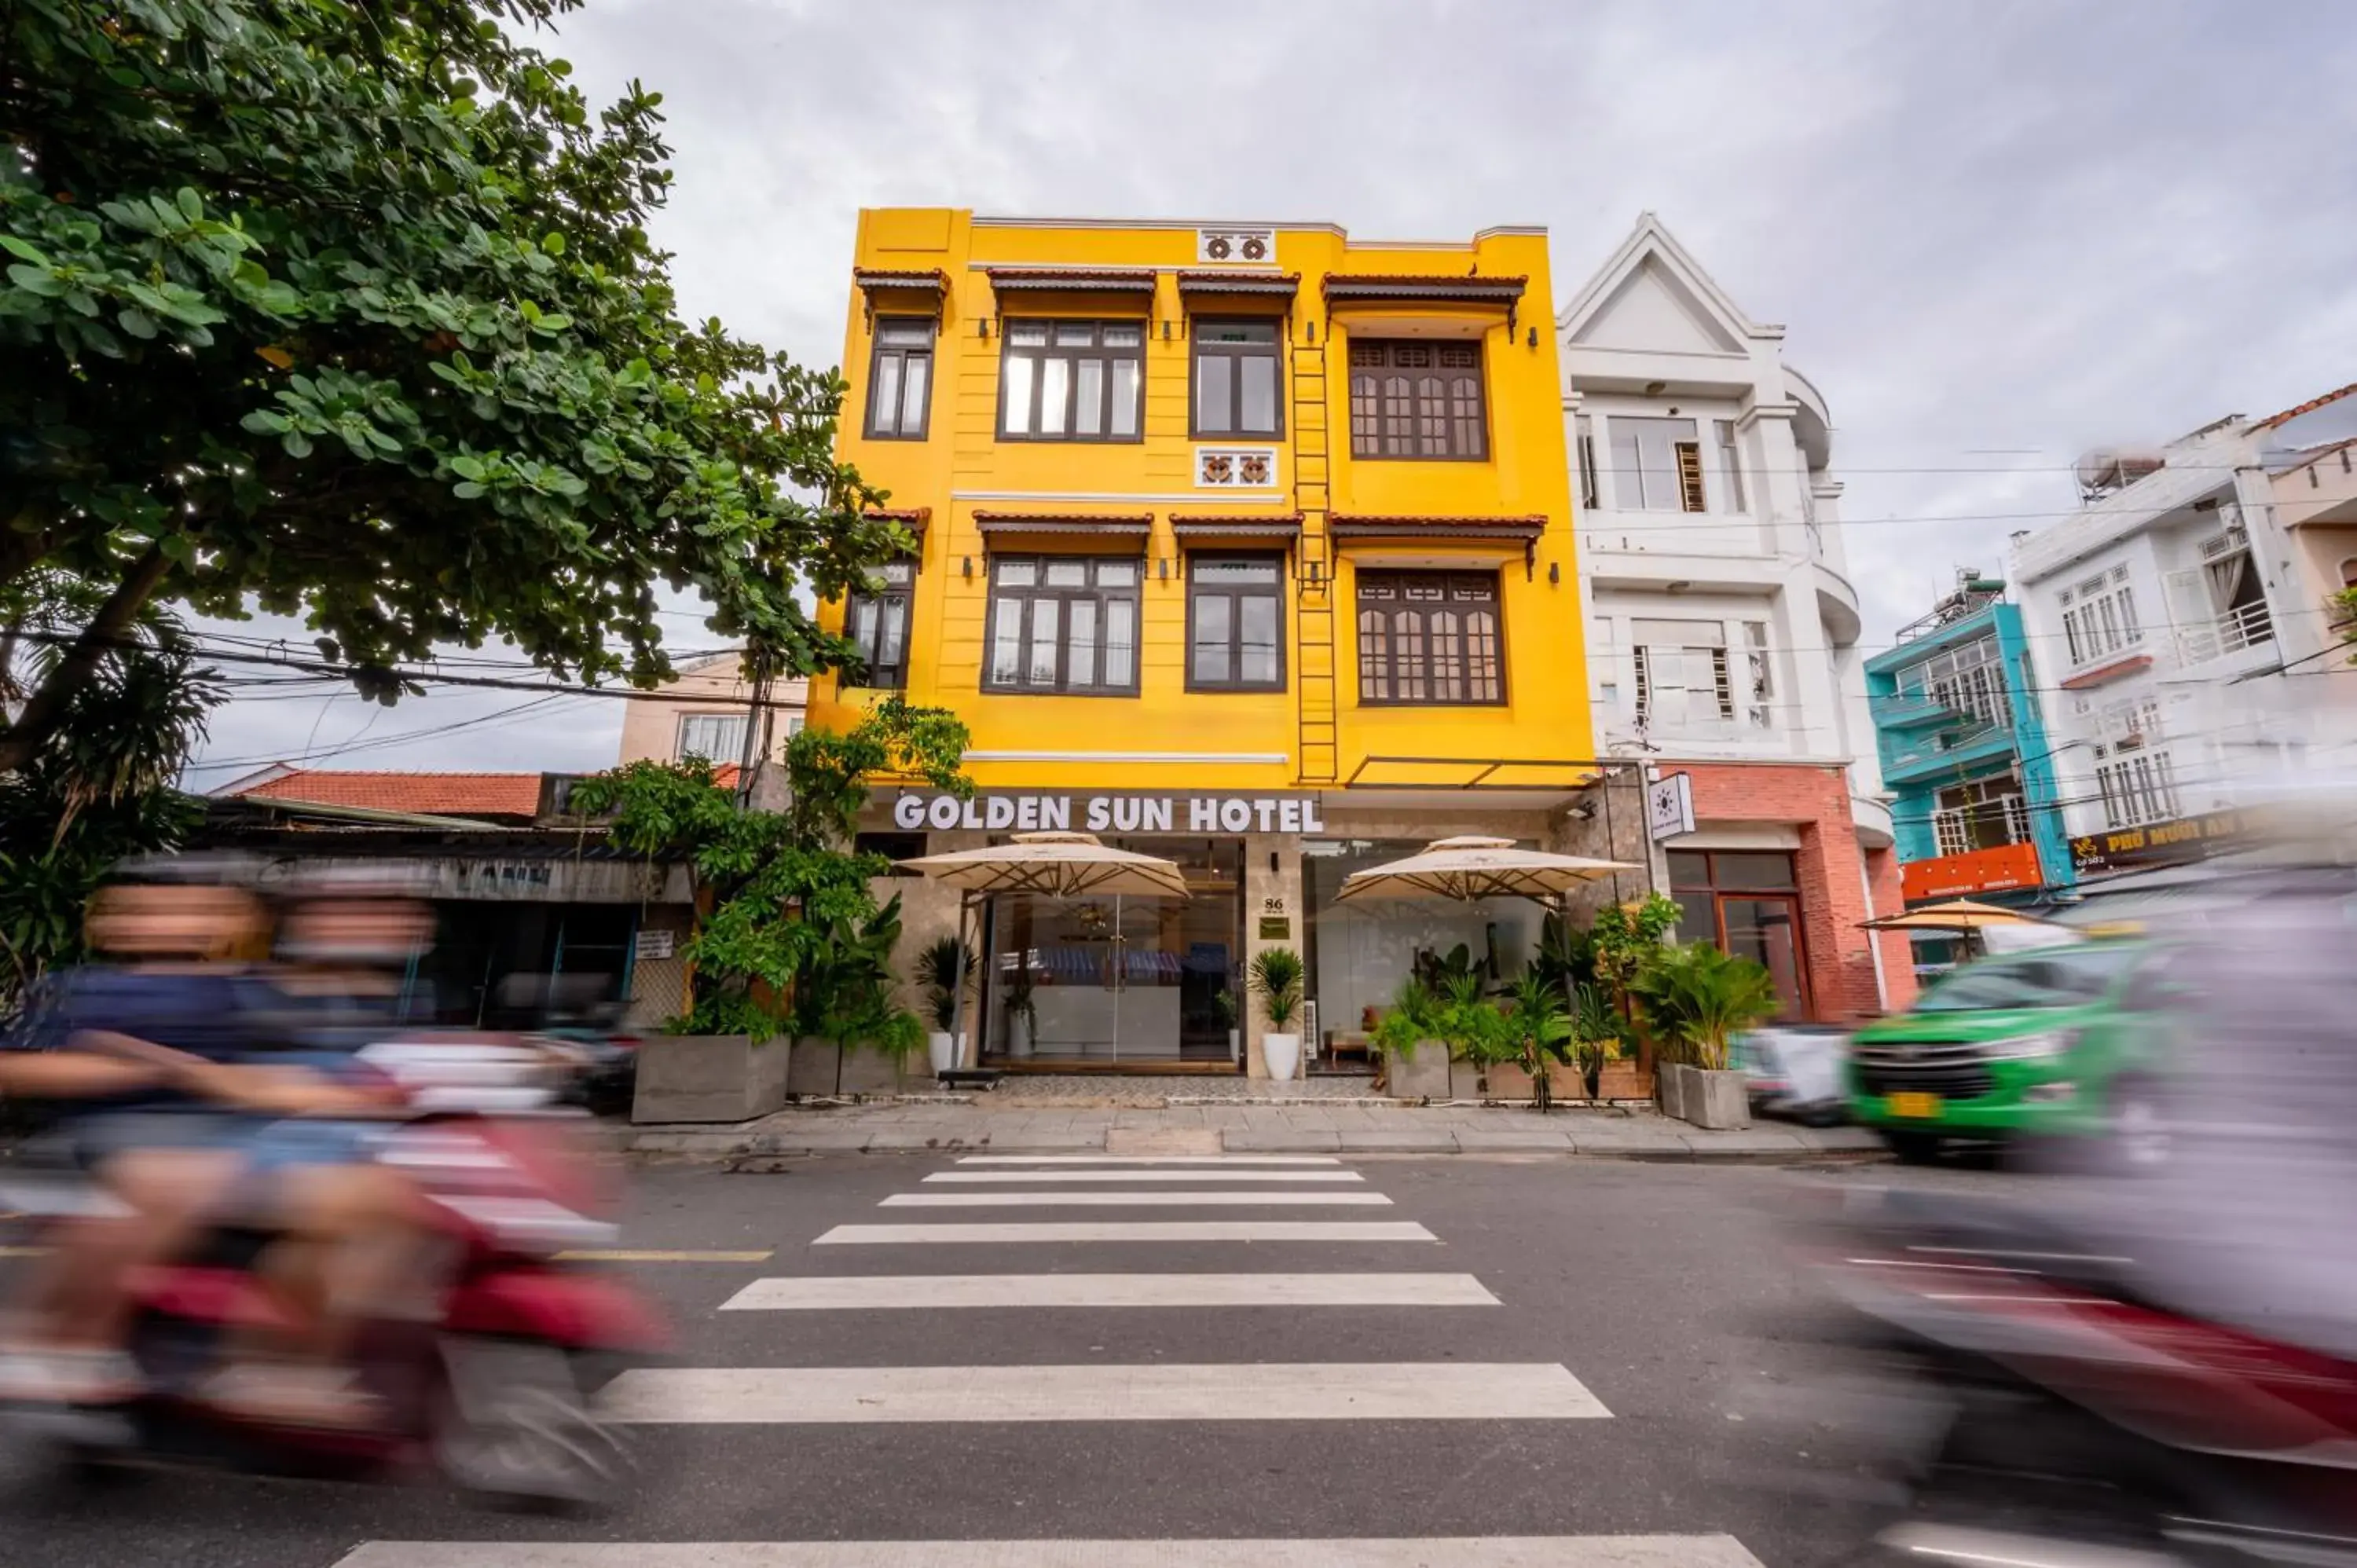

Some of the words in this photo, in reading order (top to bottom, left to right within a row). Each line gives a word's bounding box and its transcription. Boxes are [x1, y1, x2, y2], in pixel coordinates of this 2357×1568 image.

[895, 795, 1070, 830] GOLDEN
[1087, 797, 1172, 830] SUN
[1189, 798, 1324, 832] HOTEL
[1265, 898, 1283, 909] 86
